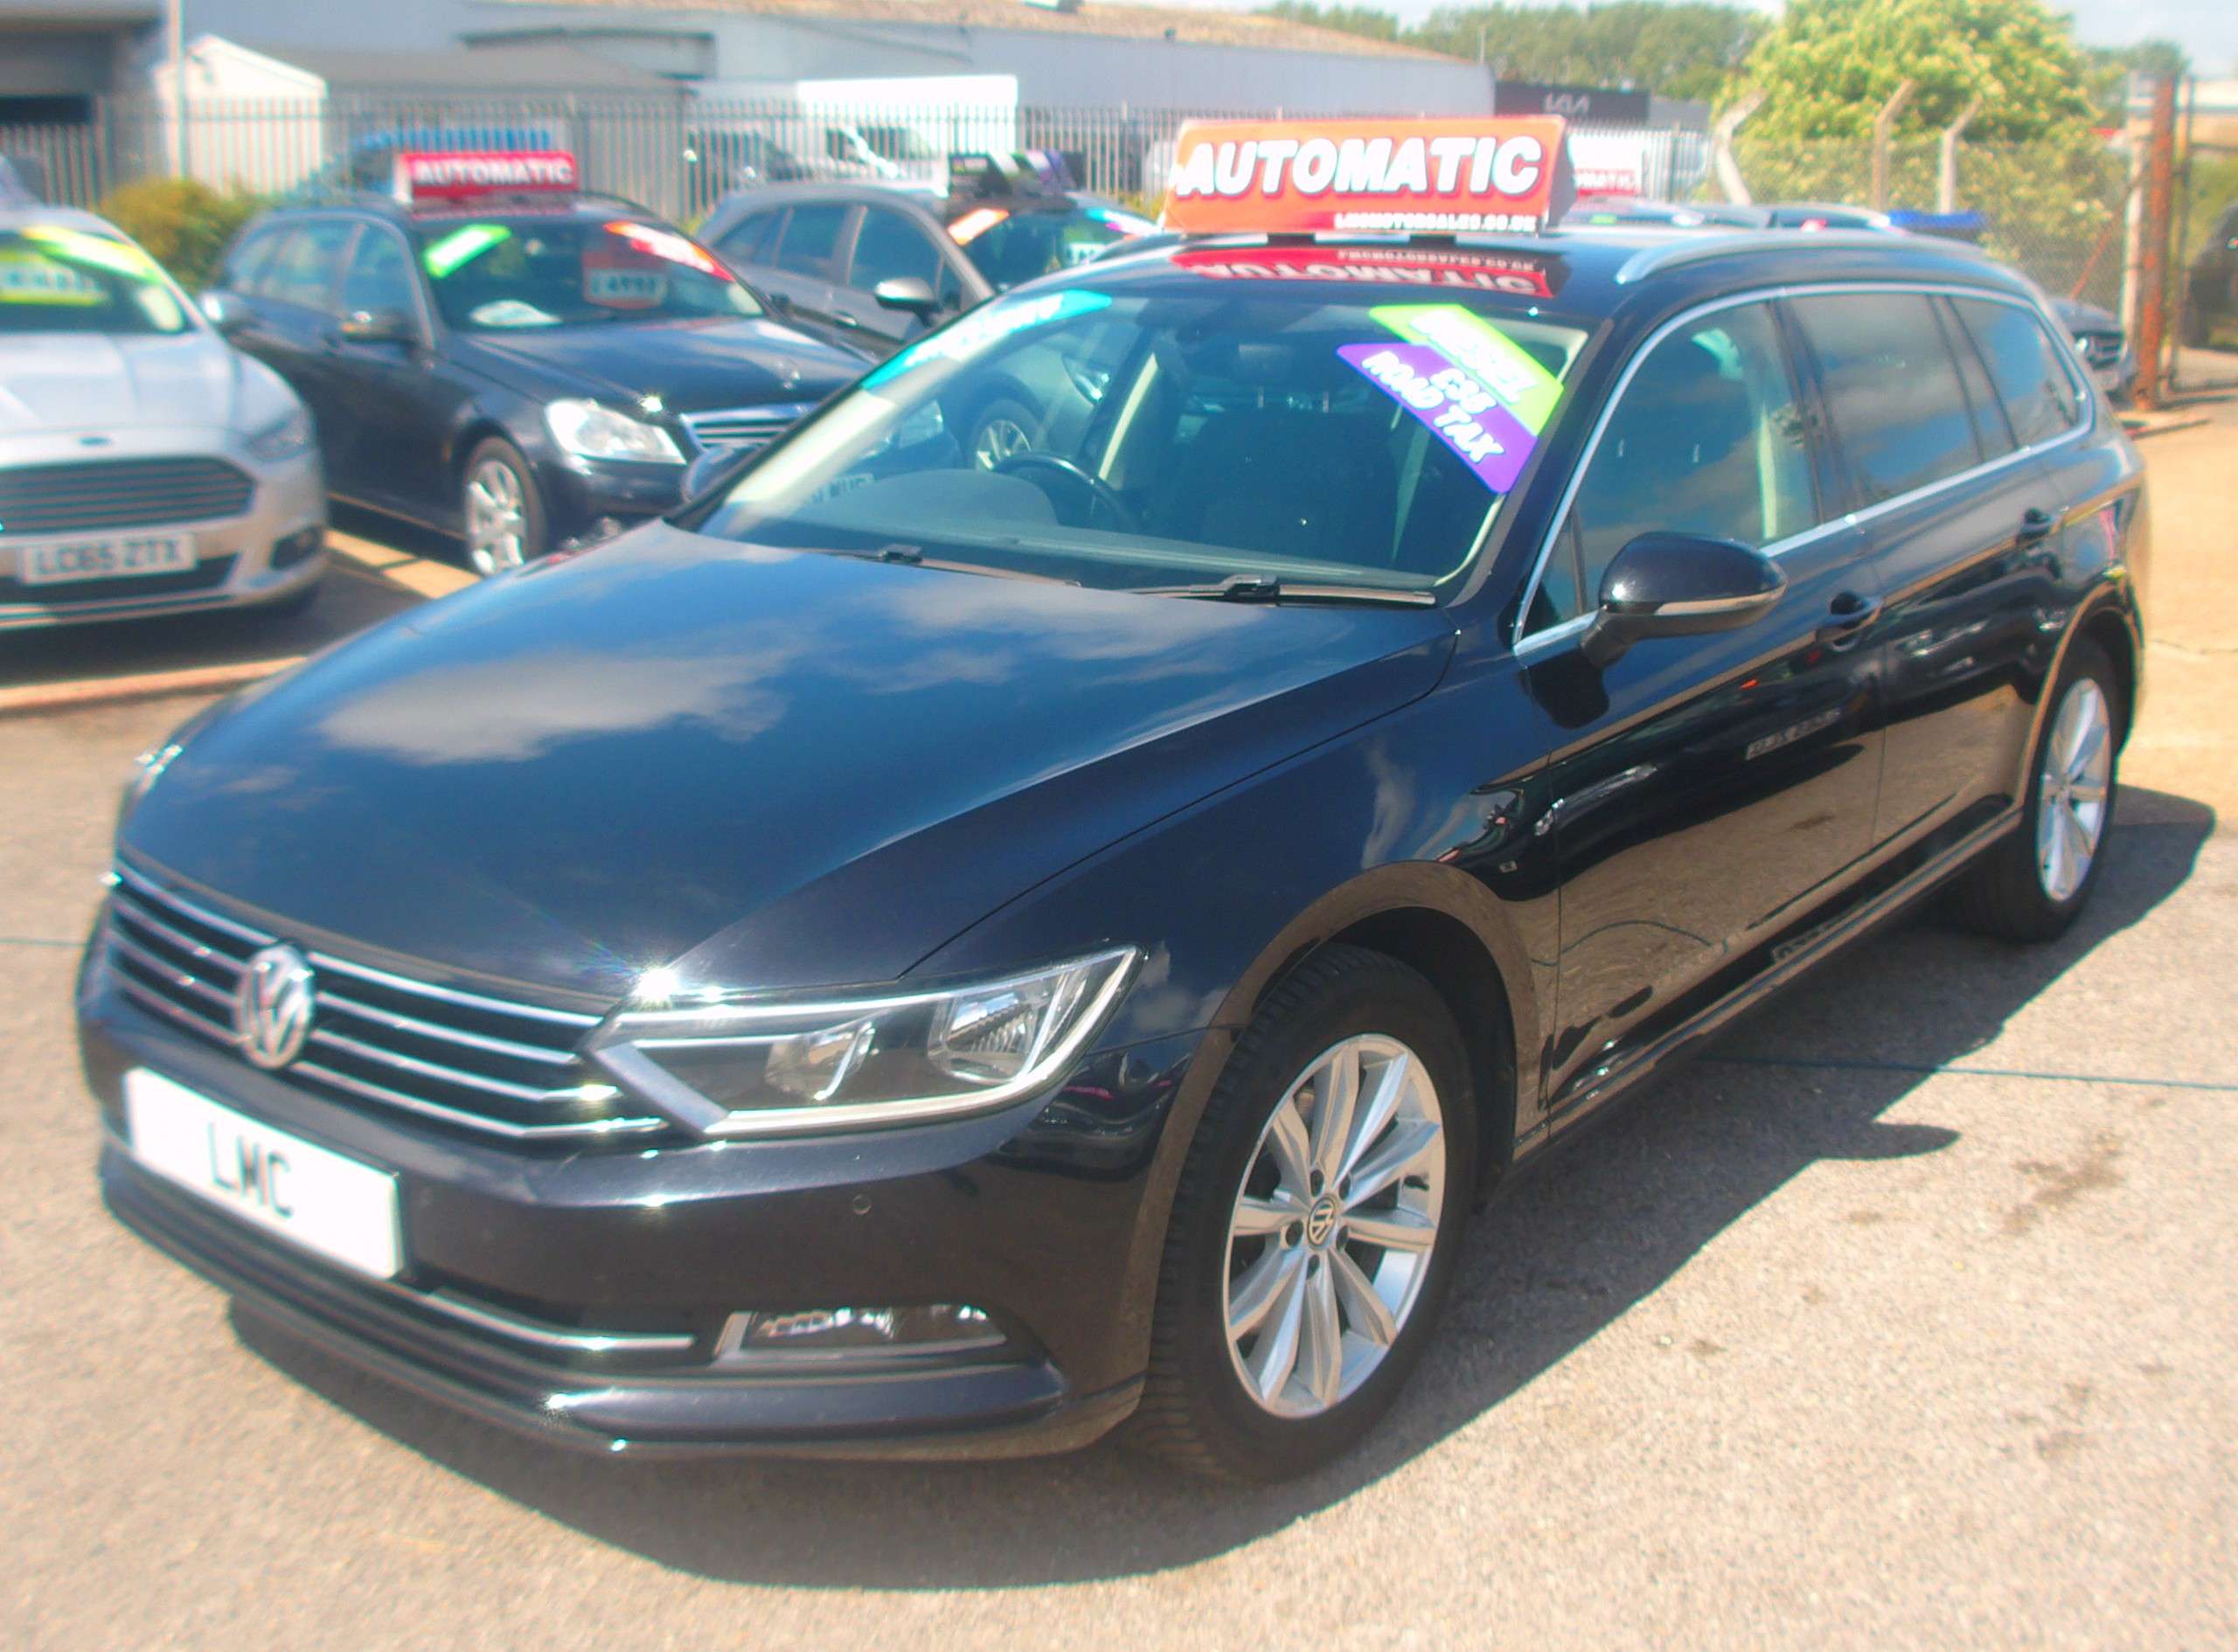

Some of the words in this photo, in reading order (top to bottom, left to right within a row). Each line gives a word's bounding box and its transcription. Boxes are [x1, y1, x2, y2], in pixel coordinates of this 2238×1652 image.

[414, 157, 573, 185] AUTOMATIC
[1173, 135, 1543, 196] AUTOMATIC
[1361, 351, 1444, 410] ROAD
[1434, 405, 1504, 463] TAX
[206, 1121, 295, 1219] LMC
